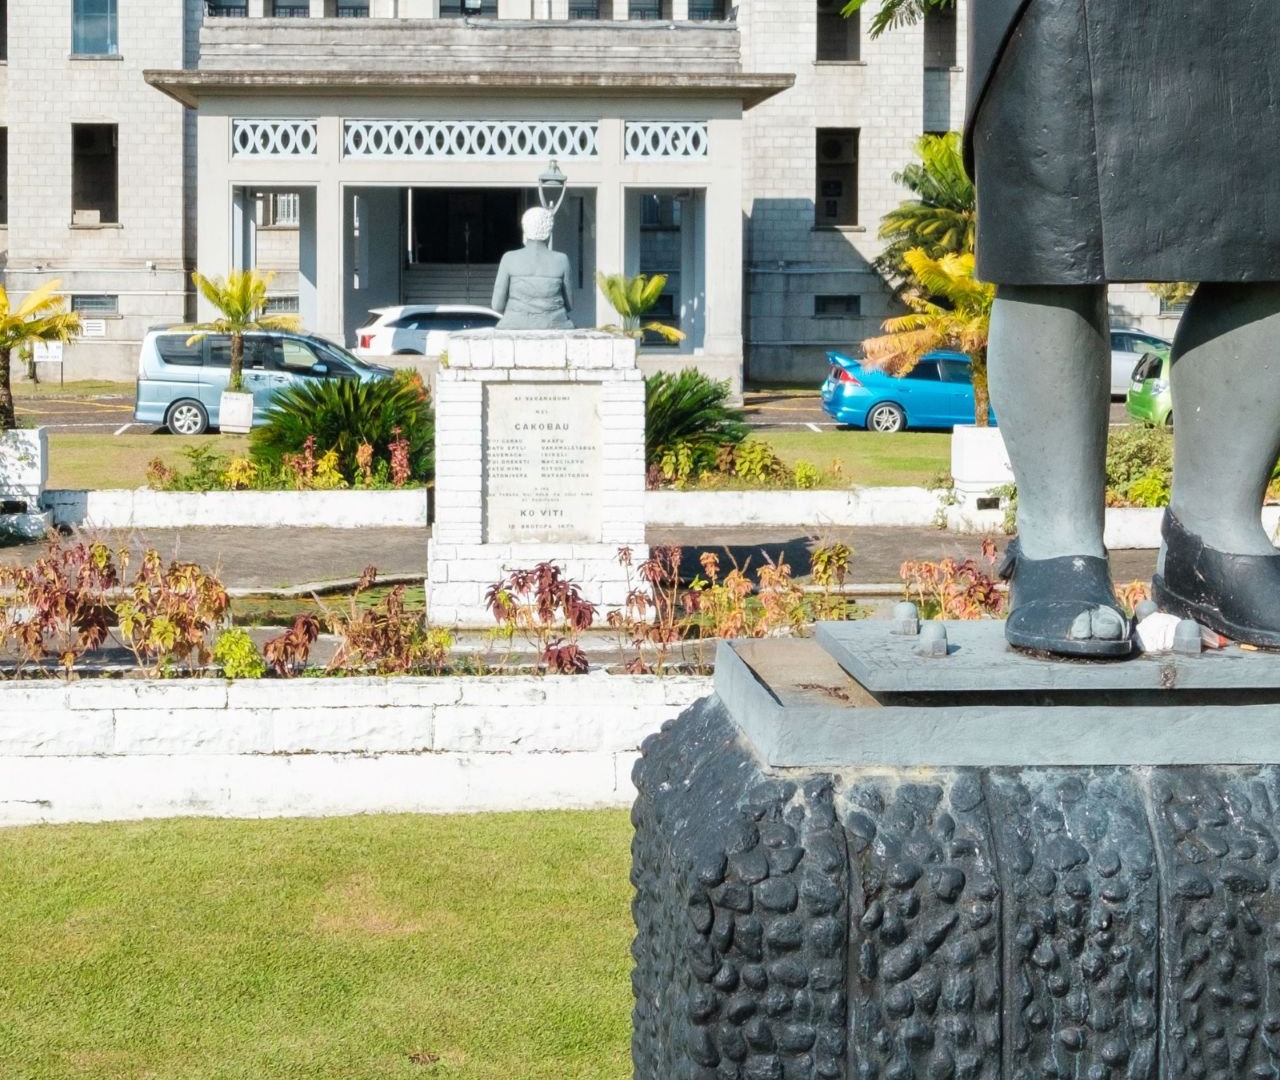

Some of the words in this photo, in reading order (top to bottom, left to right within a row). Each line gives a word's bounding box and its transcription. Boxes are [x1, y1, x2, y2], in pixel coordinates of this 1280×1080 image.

[514, 422, 570, 431] CAKOBAU
[520, 509, 535, 517] KO
[540, 509, 564, 517] VITI
